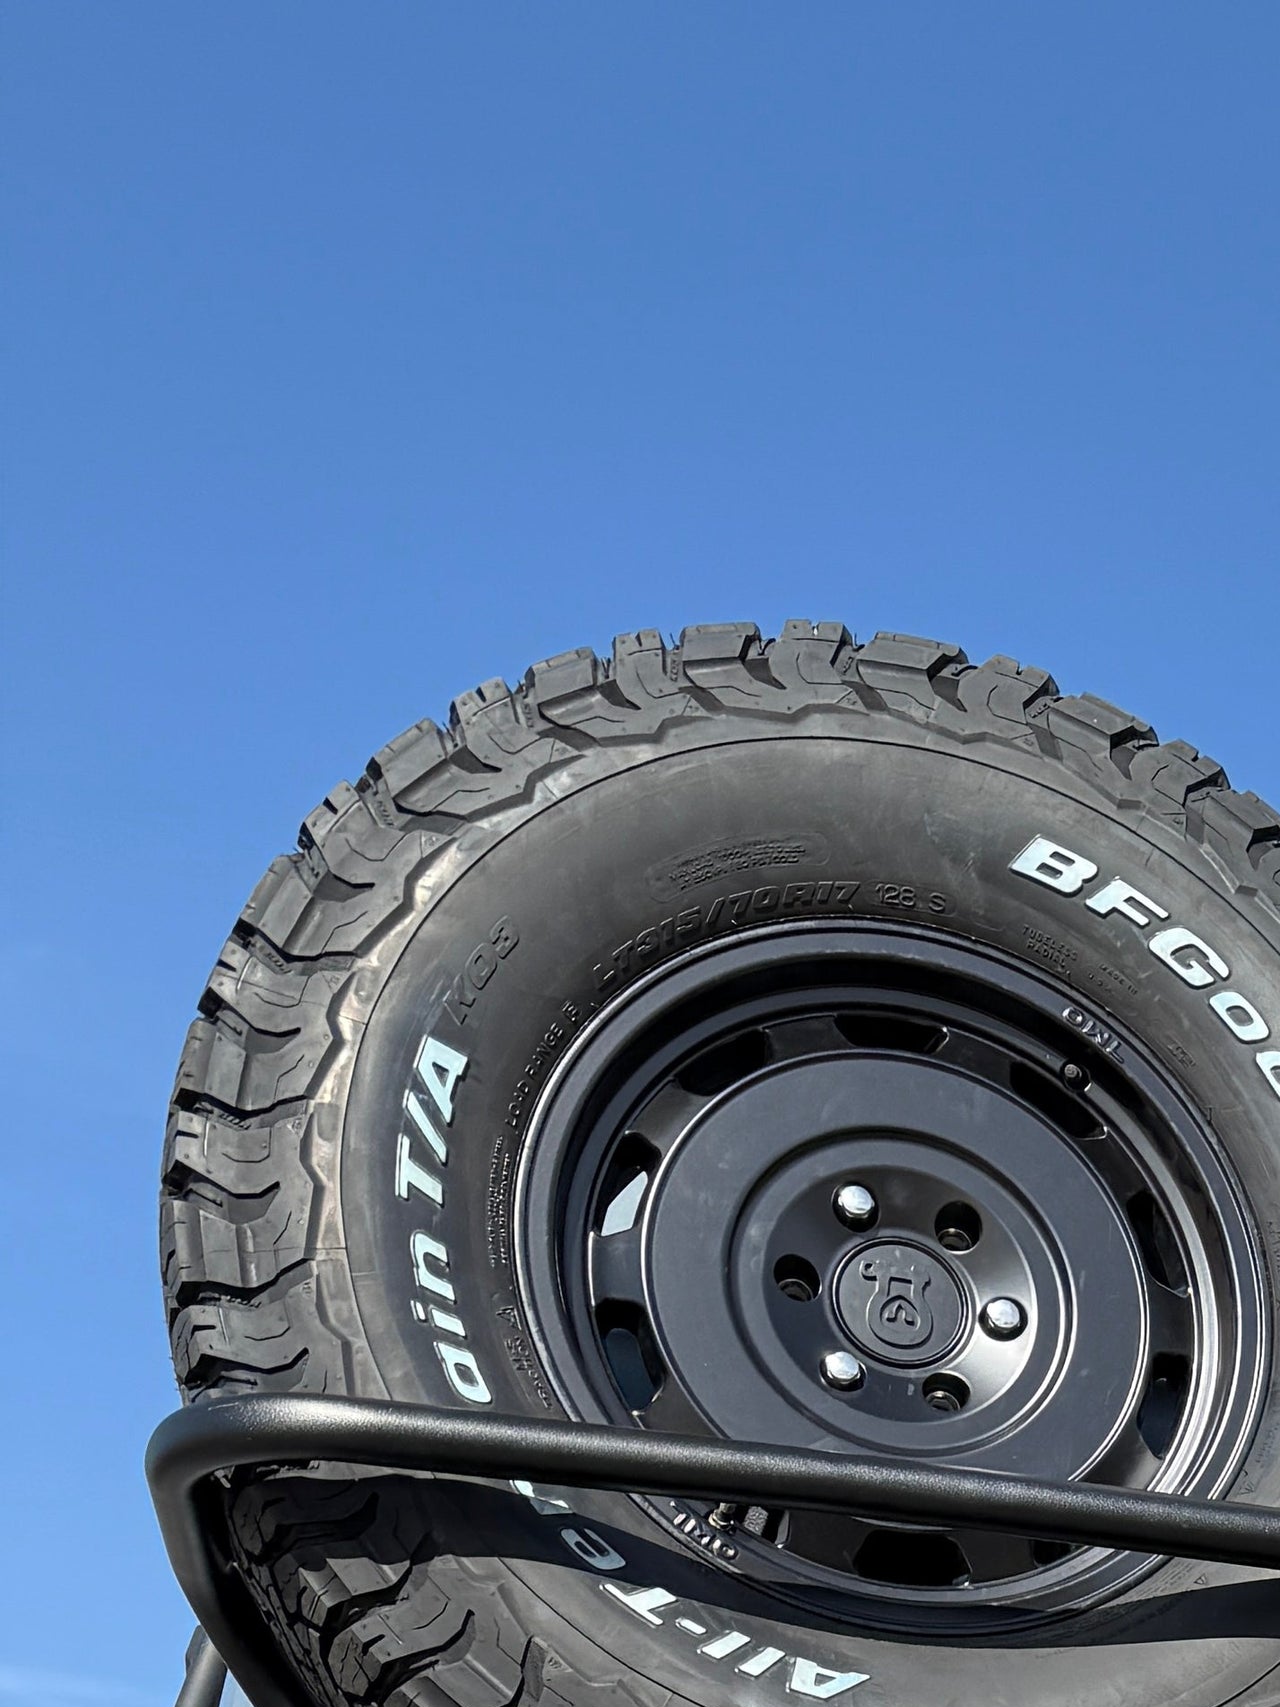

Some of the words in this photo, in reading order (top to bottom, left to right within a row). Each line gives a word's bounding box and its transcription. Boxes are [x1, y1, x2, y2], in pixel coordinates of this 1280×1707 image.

[592, 880, 860, 990] LT315/70R17
[394, 1034, 468, 1208] T/A
[442, 915, 520, 1027] KO3
